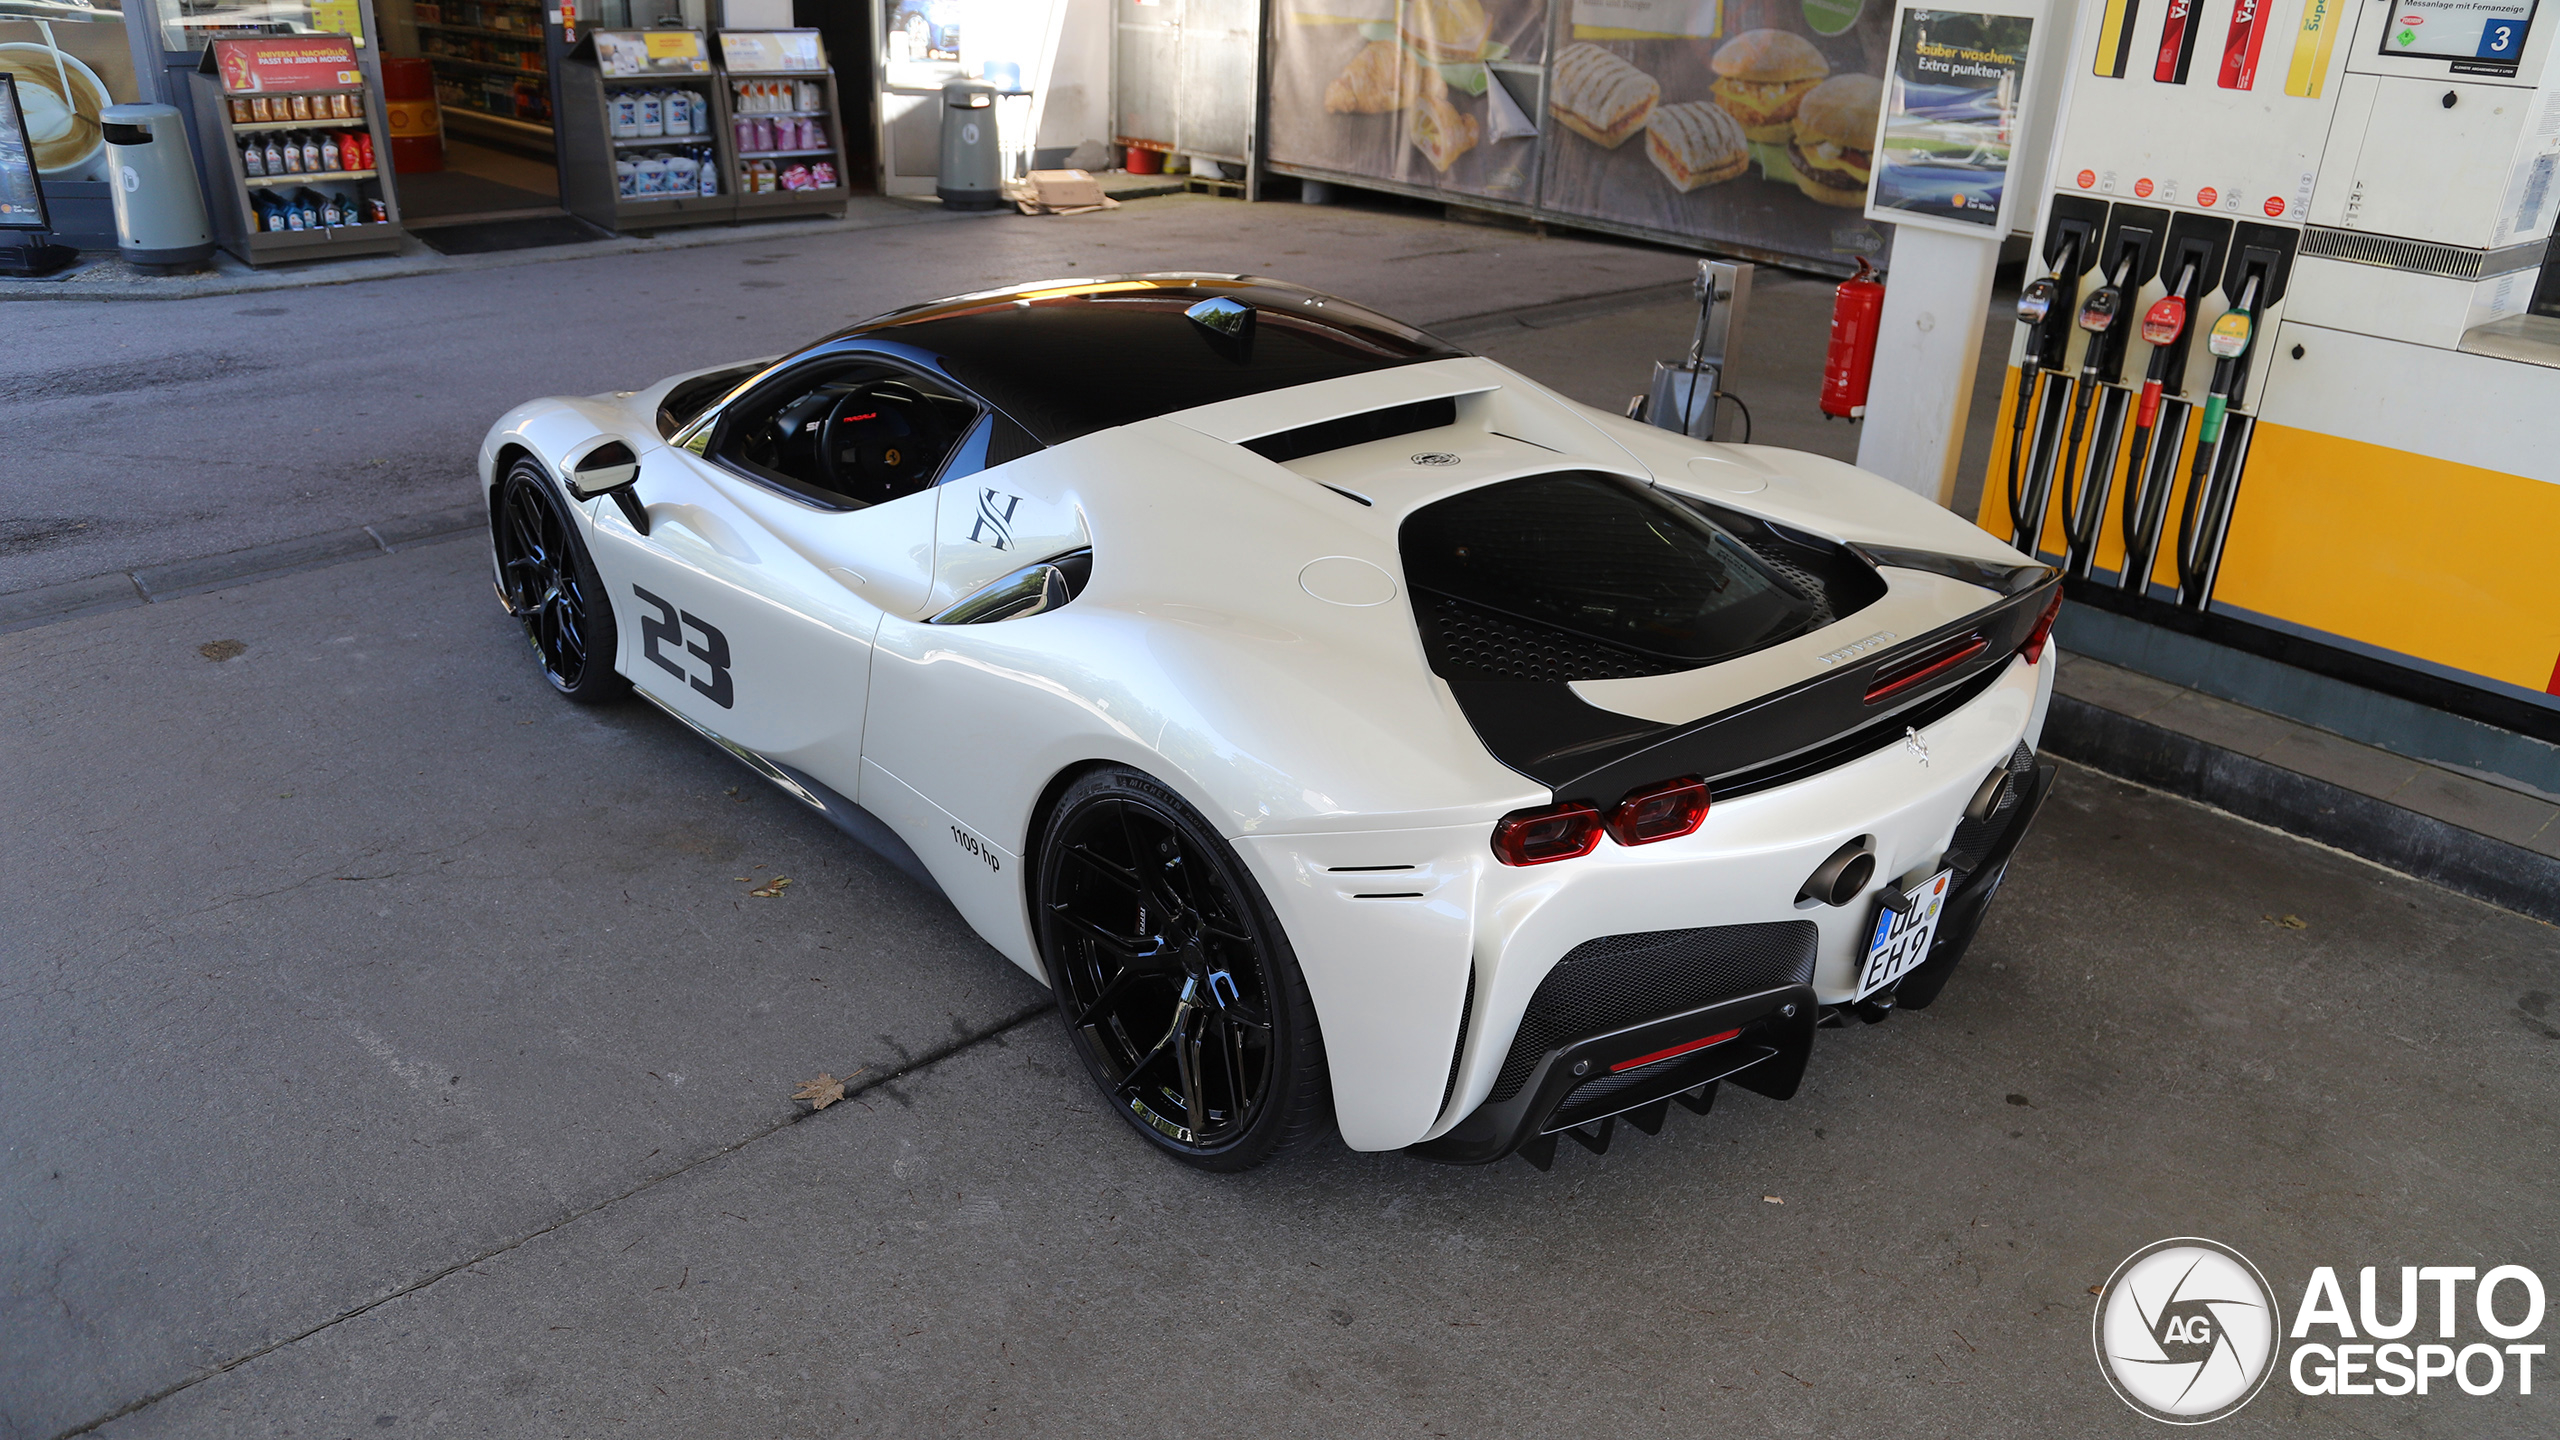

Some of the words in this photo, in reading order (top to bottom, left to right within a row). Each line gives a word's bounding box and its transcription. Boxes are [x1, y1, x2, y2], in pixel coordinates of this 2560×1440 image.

[2455, 2, 2471, 10] mit
[2472, 3, 2525, 14] Fernanzeige
[2490, 26, 2511, 52] 3
[320, 55, 350, 63] MOTOR.
[1916, 41, 1958, 58] Sauber
[1960, 48, 2015, 65] waschen.
[1918, 57, 1949, 73] Extra
[632, 582, 735, 710] 23
[1129, 778, 1183, 811] MICHELIN
[951, 825, 979, 856] 1109
[981, 842, 1000, 873] hp
[1864, 936, 1909, 992] EH
[1908, 925, 1929, 966] 9
